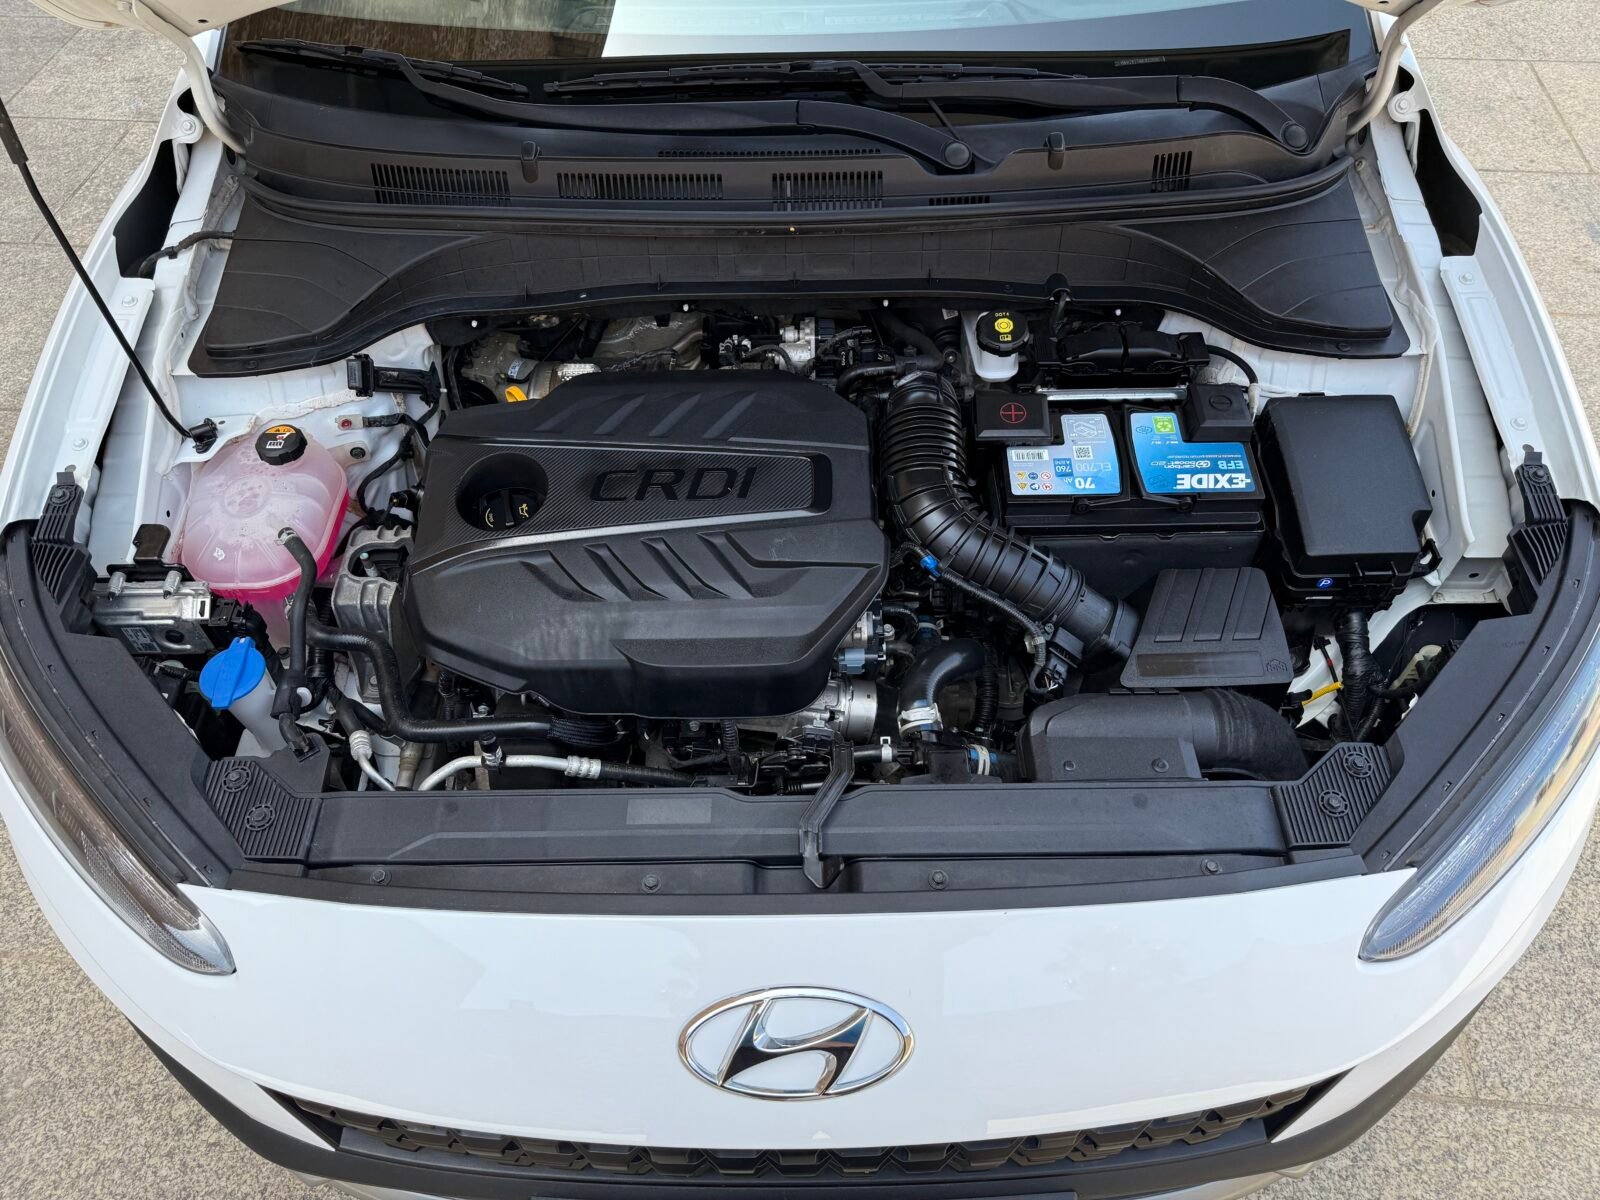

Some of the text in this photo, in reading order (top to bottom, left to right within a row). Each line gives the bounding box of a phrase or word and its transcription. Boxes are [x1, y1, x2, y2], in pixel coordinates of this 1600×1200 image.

[1055, 465, 1072, 473] 760
[1075, 462, 1112, 472] EL700
[1217, 460, 1245, 470] EFB
[590, 467, 758, 502] CRDI
[1075, 477, 1096, 489] 70
[1175, 473, 1251, 489] EXIDE
